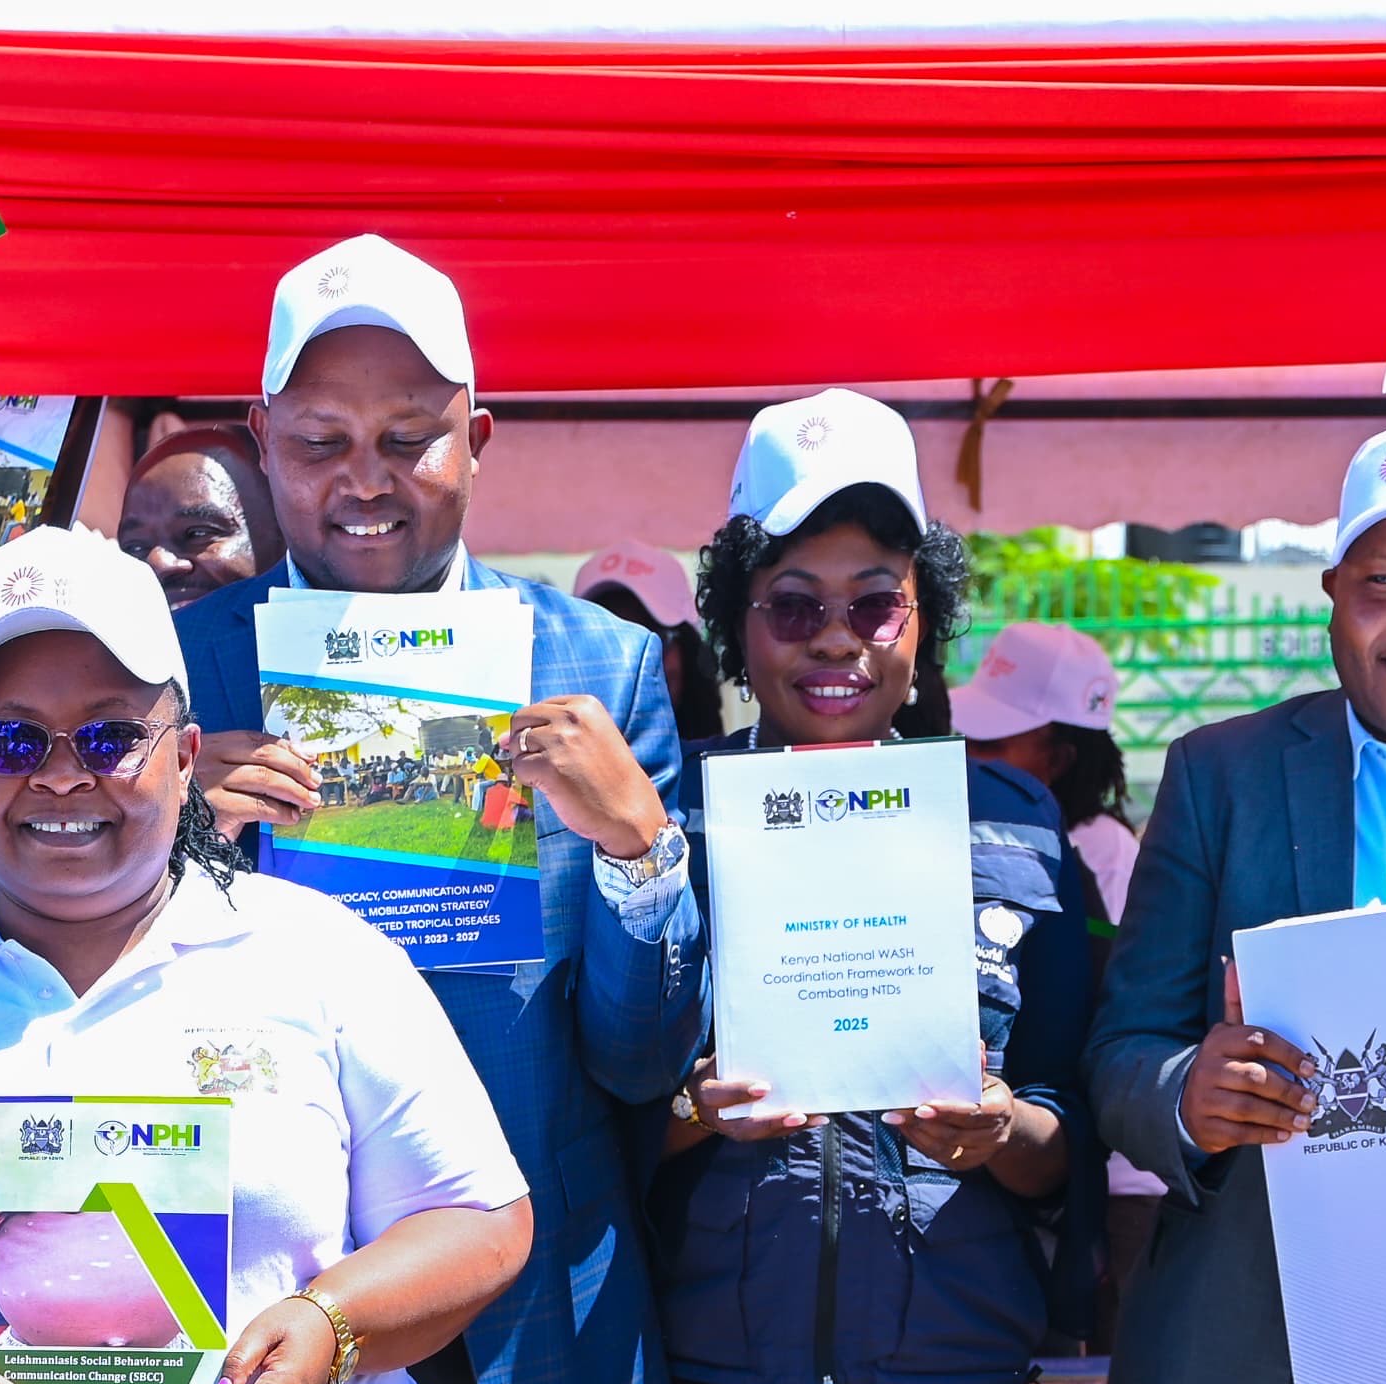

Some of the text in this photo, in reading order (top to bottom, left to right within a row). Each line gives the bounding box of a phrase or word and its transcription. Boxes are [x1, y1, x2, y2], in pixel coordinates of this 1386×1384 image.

[400, 628, 453, 648] NPHI
[849, 788, 910, 811] NPHI
[382, 885, 470, 901] COMMUNICATION
[473, 884, 494, 894] AND
[369, 903, 438, 917] MOBILIZATION
[441, 900, 490, 912] STRATEGY
[405, 917, 453, 929] TROPICAL
[455, 914, 501, 927] DISEASES
[785, 915, 907, 933] MINISTRY OF HEALTH
[424, 934, 448, 944] 2023
[456, 931, 480, 942] 2027
[781, 947, 914, 966] Kenya National WASH
[763, 964, 934, 985] Coordination Framework for
[798, 984, 901, 1000] Combating NTDs
[833, 1017, 869, 1032] 2025
[131, 1123, 200, 1147] NPHI
[1303, 1140, 1357, 1155] REPUBLIC
[1361, 1138, 1375, 1149] OF
[4, 1355, 183, 1367] Leishmaniasis Social Behavior and
[3, 1370, 164, 1384] Communication Change (SBCC)
